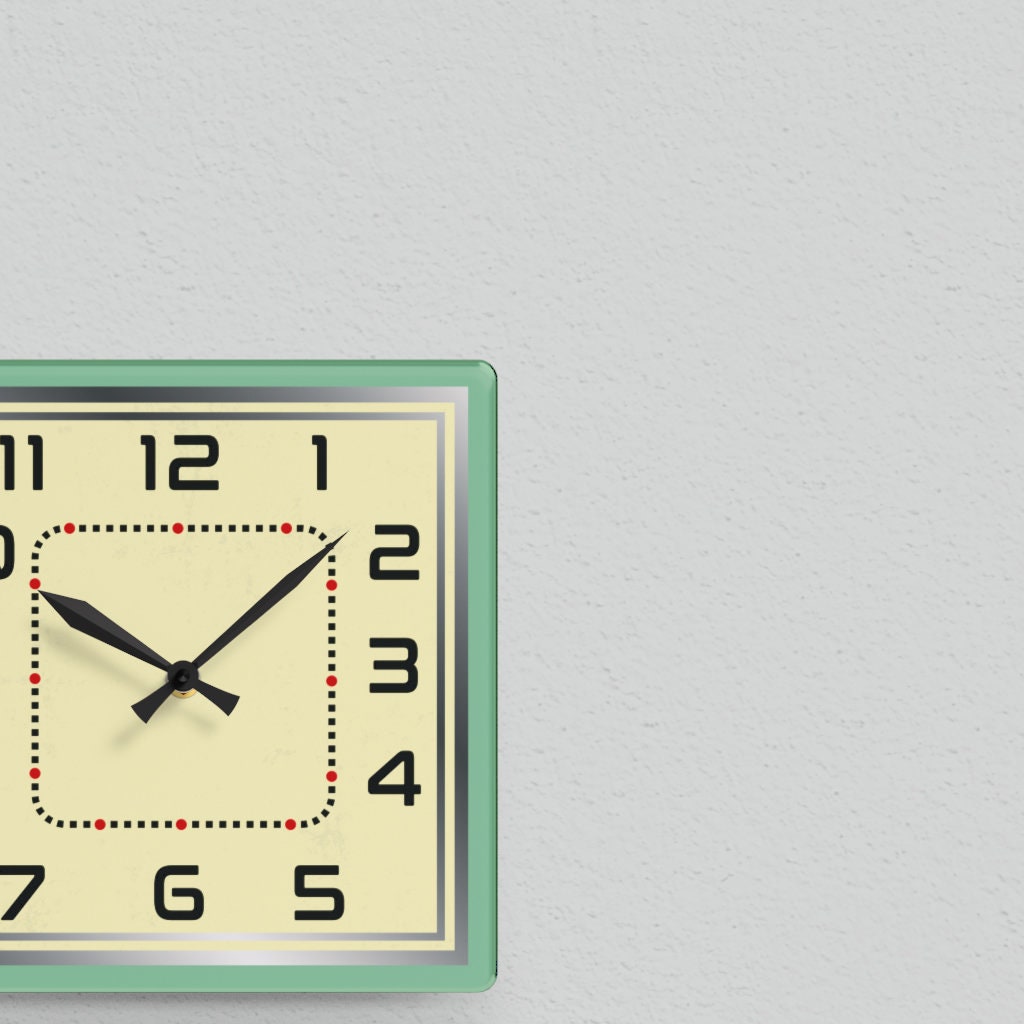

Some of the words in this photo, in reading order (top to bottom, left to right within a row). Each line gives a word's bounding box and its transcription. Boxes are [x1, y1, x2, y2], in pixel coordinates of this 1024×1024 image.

[139, 434, 220, 491] 12
[311, 434, 328, 491] 1
[369, 523, 421, 581] 2
[368, 637, 419, 694] 3
[367, 750, 422, 807] 4
[153, 864, 205, 921] 6
[294, 864, 346, 921] 5
